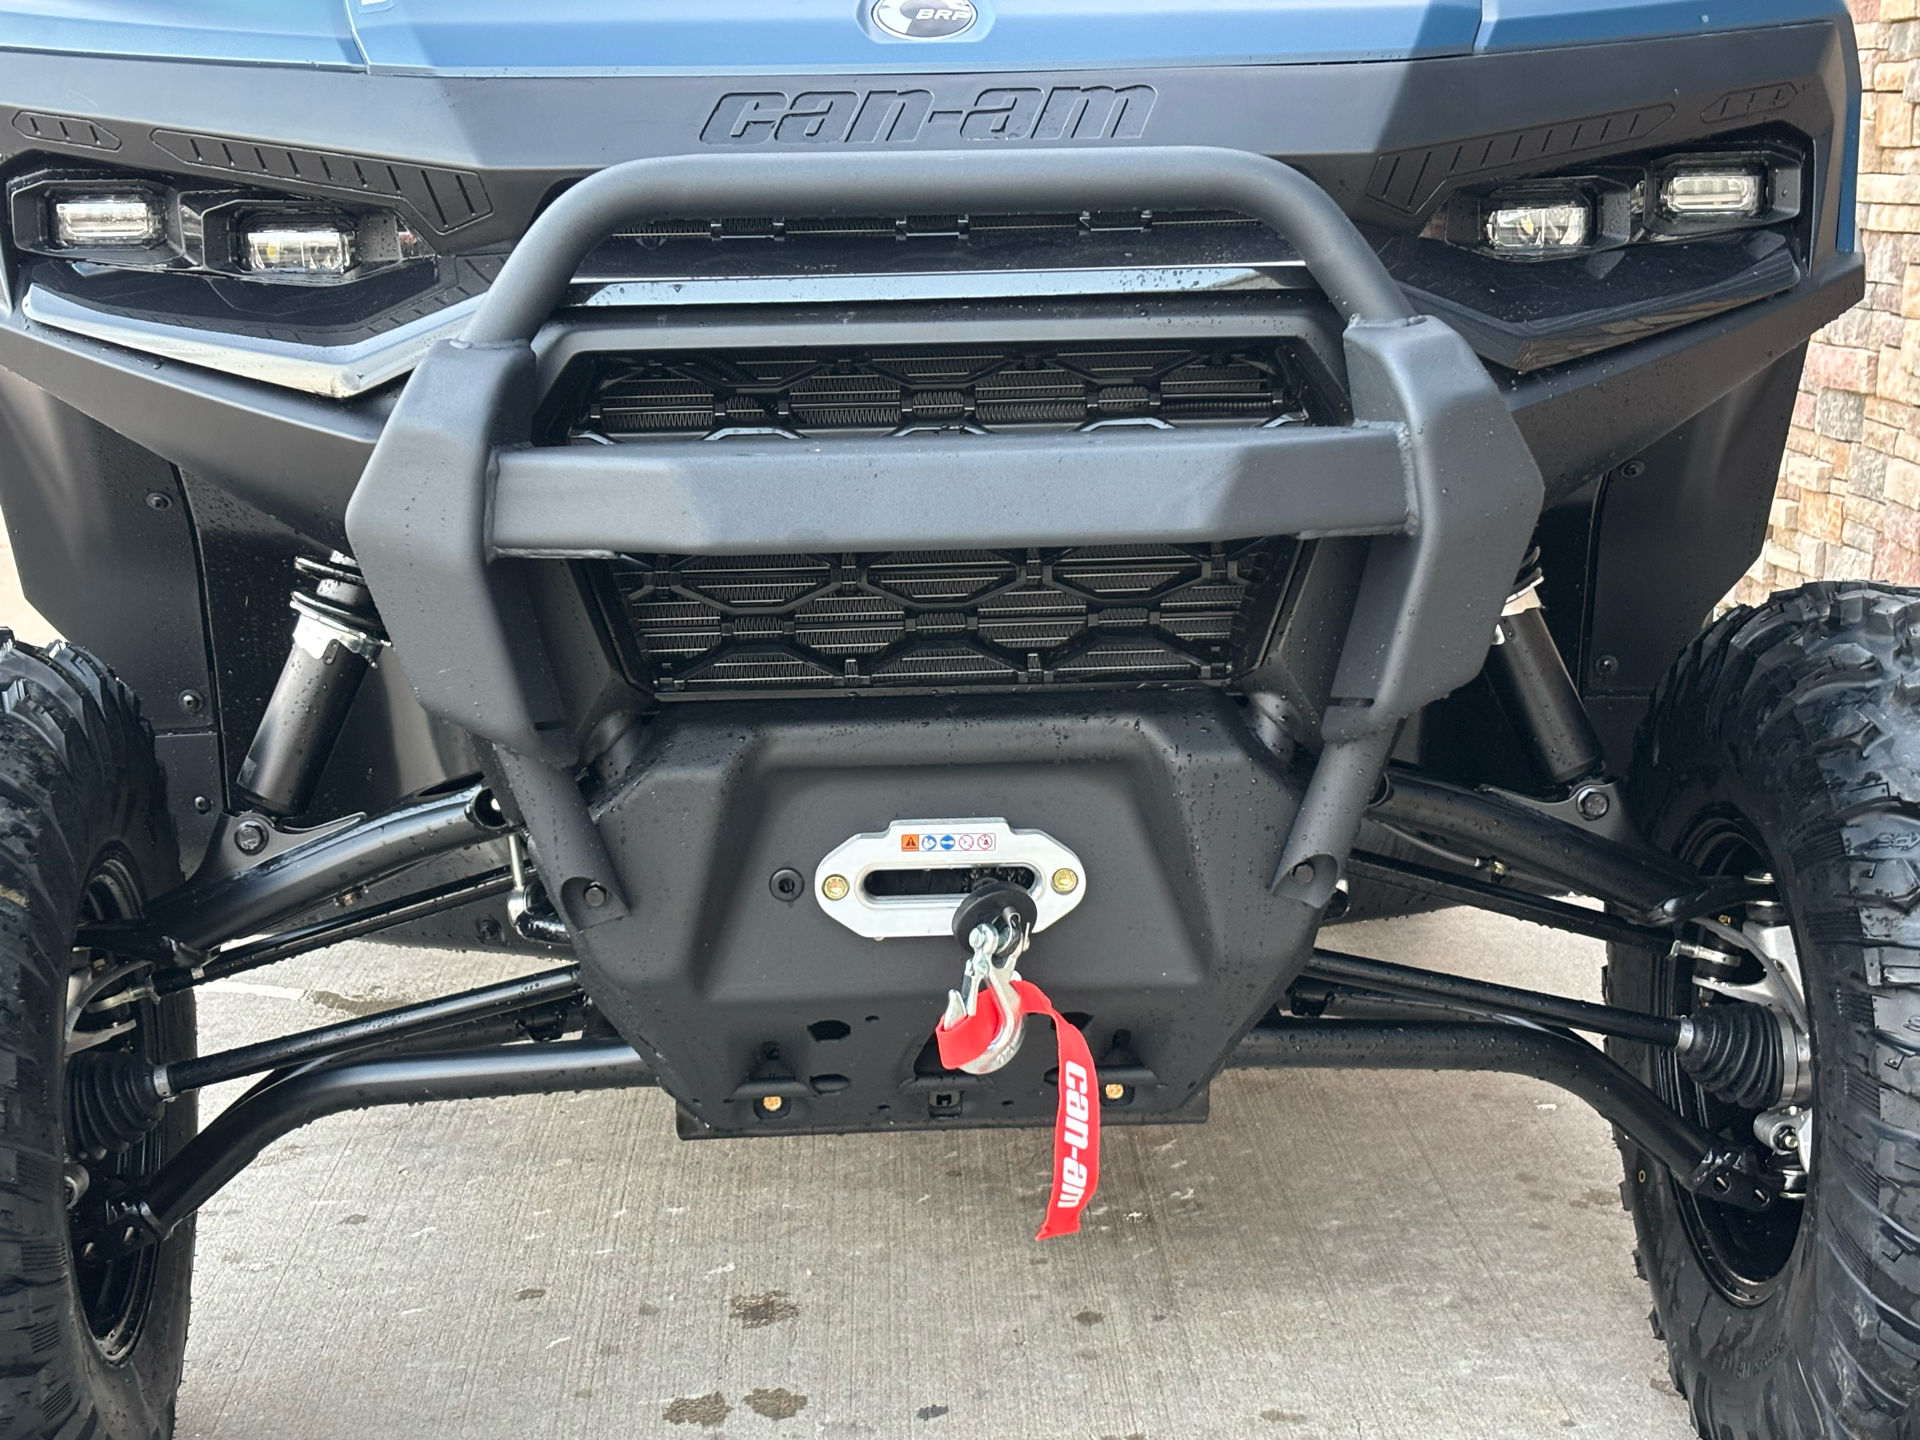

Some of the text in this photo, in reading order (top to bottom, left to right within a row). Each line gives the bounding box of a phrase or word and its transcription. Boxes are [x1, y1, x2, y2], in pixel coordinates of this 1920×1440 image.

[916, 8, 972, 21] BRP
[699, 84, 1158, 145] can-am
[1057, 1060, 1089, 1208] can-am
